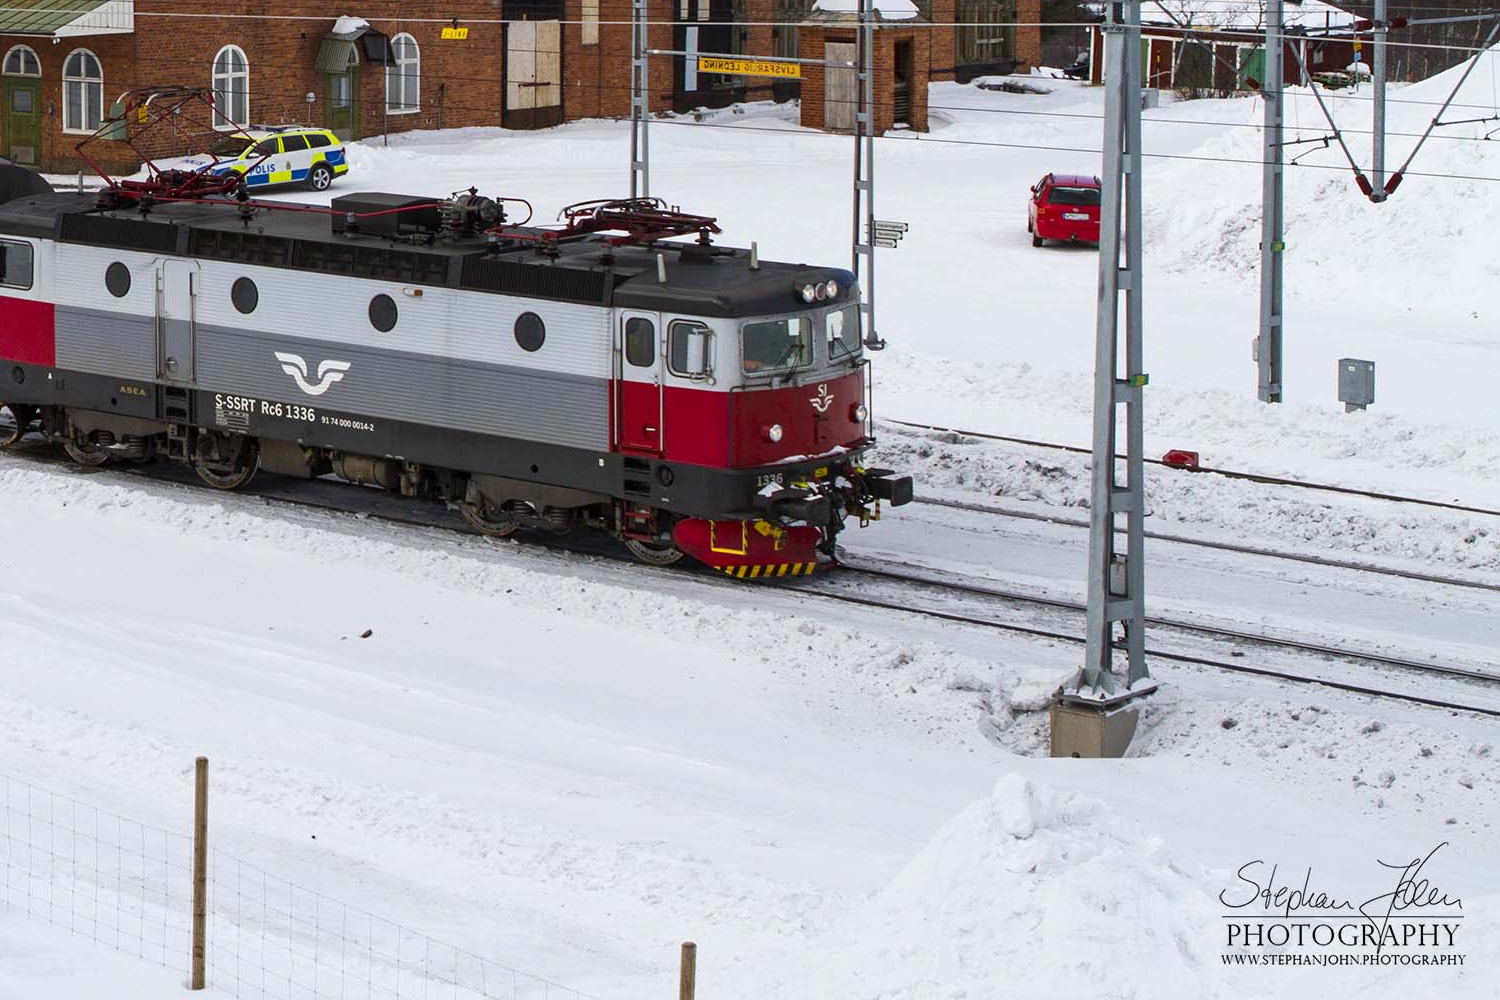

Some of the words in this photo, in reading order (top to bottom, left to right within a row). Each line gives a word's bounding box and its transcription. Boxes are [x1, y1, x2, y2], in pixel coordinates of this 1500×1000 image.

[119, 385, 147, 397] ASEA
[818, 383, 828, 397] SJ
[215, 393, 256, 412] S-SSRT
[261, 400, 283, 417] Rc6
[285, 405, 316, 422] 1336
[321, 415, 330, 425] 91
[757, 473, 784, 487] 1336
